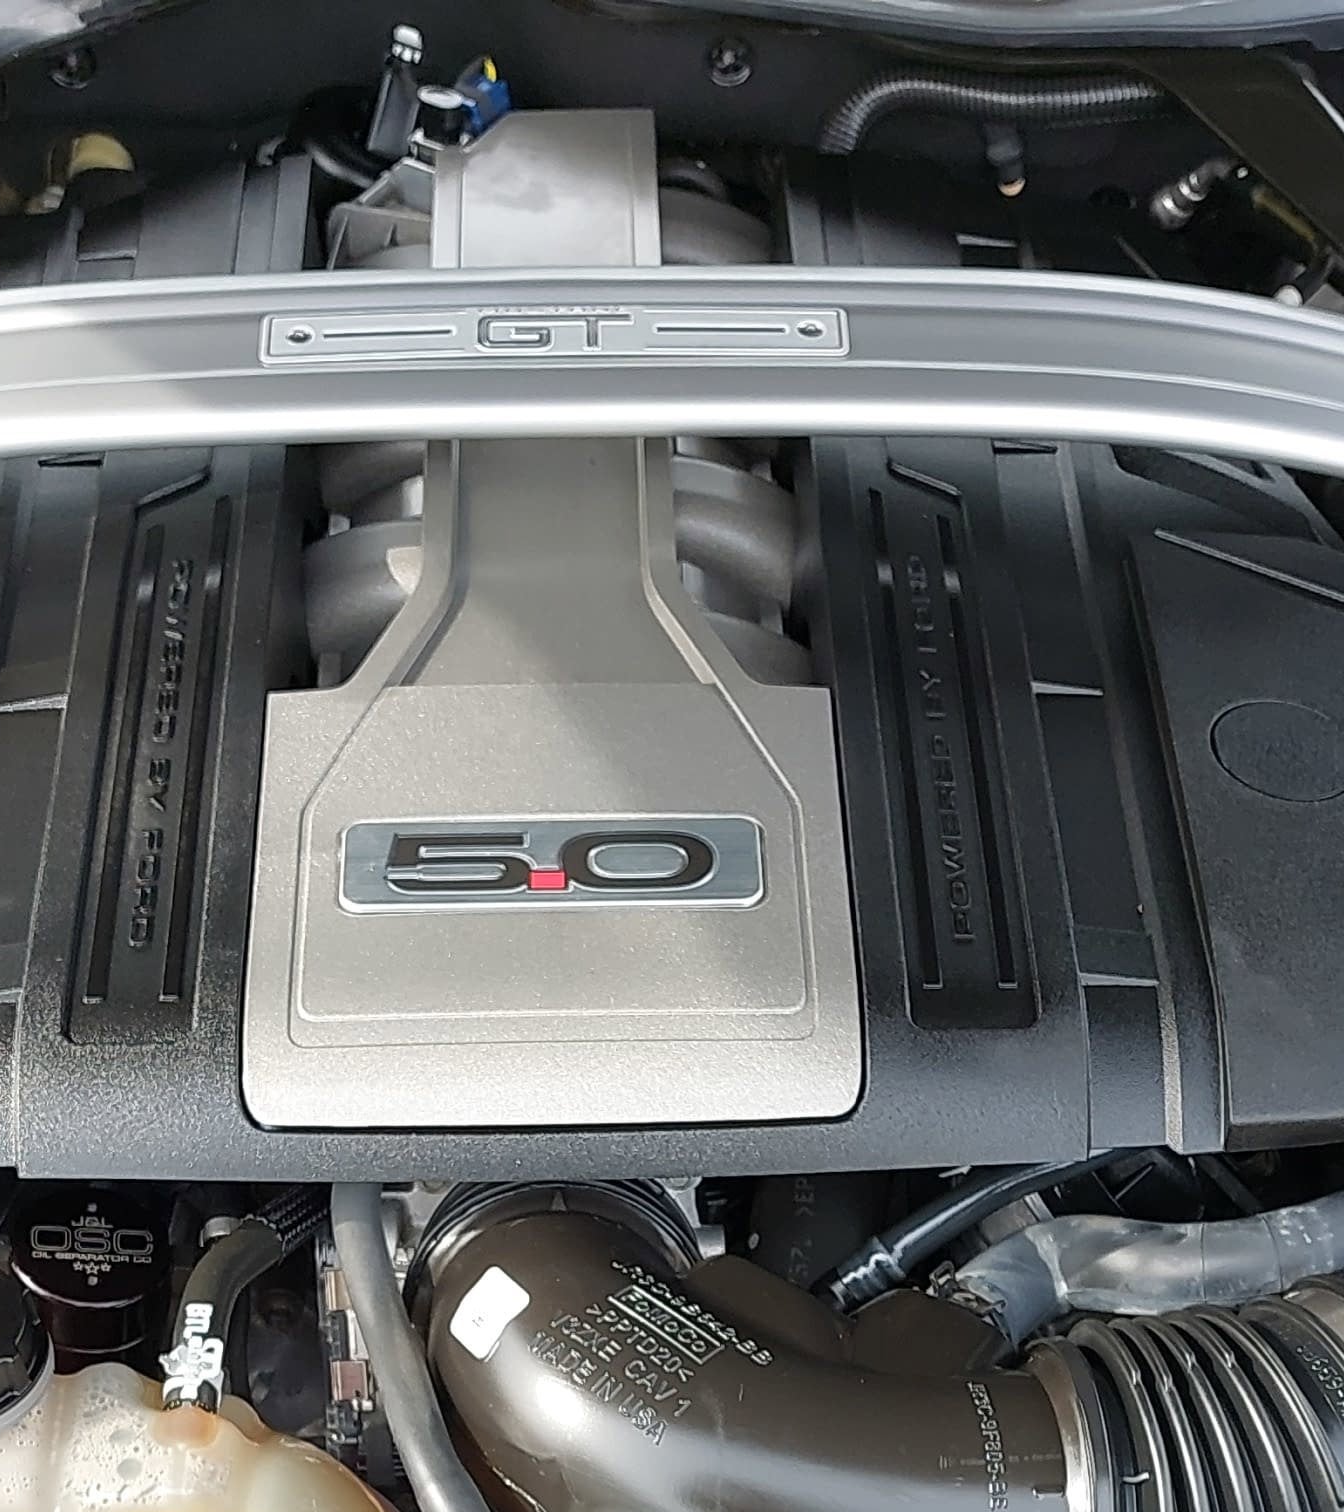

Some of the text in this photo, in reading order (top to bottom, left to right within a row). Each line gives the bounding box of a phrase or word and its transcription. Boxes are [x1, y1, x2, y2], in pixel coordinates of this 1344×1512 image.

[477, 313, 634, 352] GT
[128, 559, 193, 949] POWERED BY FORD
[384, 829, 718, 893] 5.0
[930, 735, 976, 943] POWERED
[31, 1225, 154, 1256] OSC
[31, 1250, 152, 1264] OIL SEPARATOR CO
[620, 1290, 709, 1355] FoMoCo
[527, 1330, 669, 1447] MADE IN USA
[624, 1359, 678, 1403] CAV
[673, 1397, 693, 1418] 1
